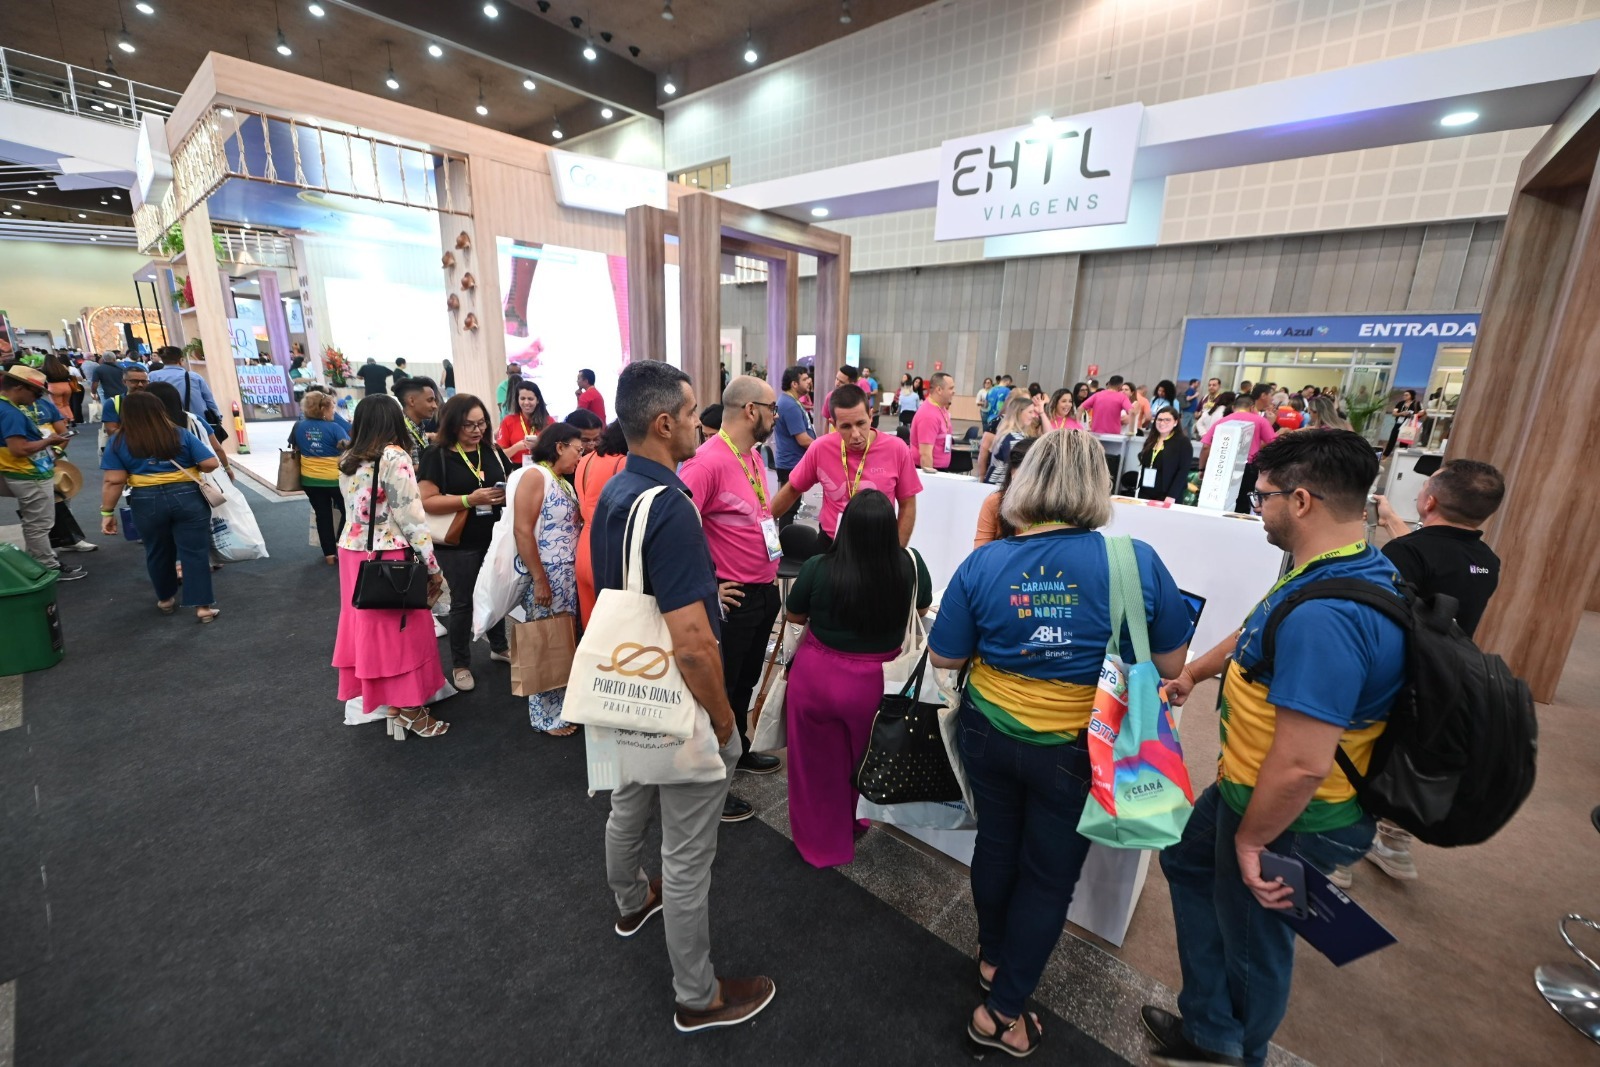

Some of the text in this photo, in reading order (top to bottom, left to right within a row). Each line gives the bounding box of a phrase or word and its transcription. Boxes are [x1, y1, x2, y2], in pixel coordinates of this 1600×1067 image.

[952, 127, 1111, 197] EHTL
[983, 194, 1099, 221] VIAGENS
[1283, 326, 1315, 337] Azul
[1358, 322, 1478, 337] ENTRADA
[239, 375, 283, 384] A MELHOR
[1021, 581, 1066, 592] CARAVANA
[1033, 593, 1079, 606] GRANDE
[1034, 606, 1072, 619] NORTE
[592, 677, 682, 705] PORTO DAS DUNAS
[603, 701, 664, 719] PRAIA HOTEL
[1089, 718, 1119, 744] BTM
[1131, 778, 1164, 795] CEARÁ
